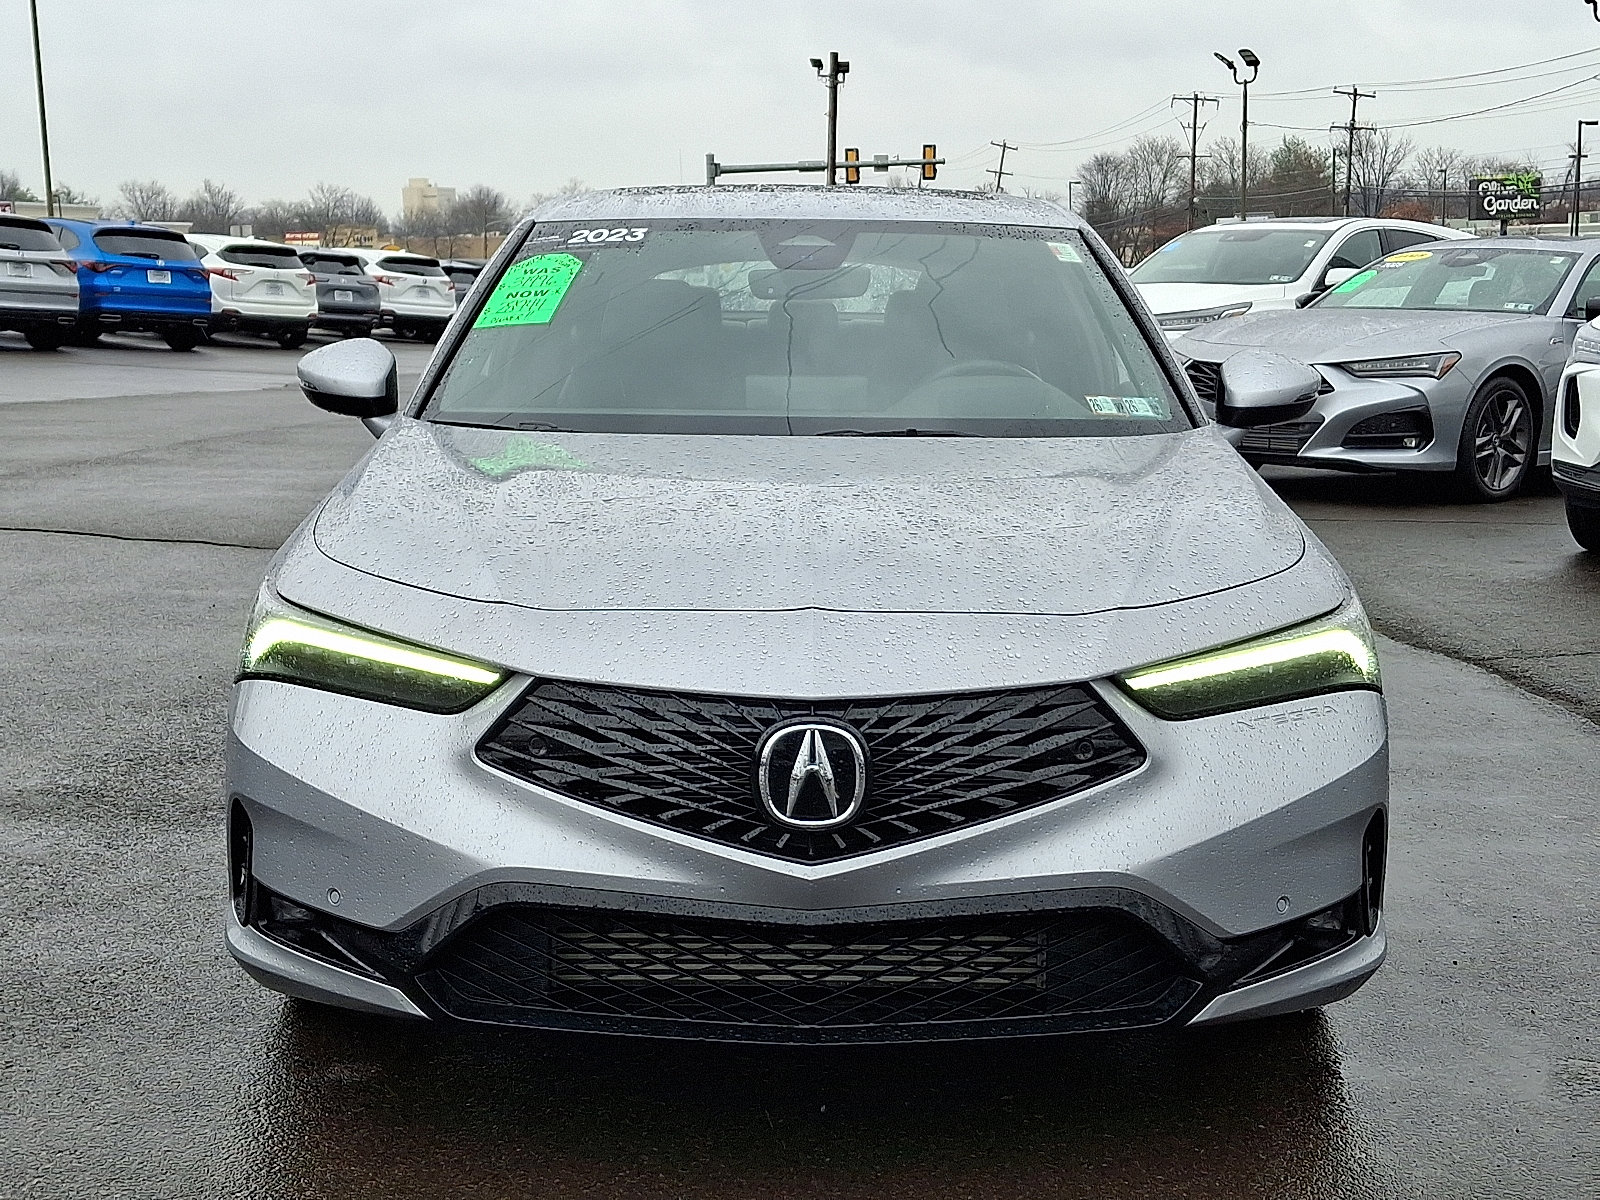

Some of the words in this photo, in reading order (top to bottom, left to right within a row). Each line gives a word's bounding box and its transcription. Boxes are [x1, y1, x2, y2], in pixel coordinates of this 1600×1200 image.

[1483, 195, 1539, 215] Garden
[567, 228, 648, 243] 2023
[523, 266, 561, 275] WAS
[505, 289, 549, 299] NOW
[1088, 398, 1103, 412] 26
[1231, 705, 1338, 732] NTEGRA
